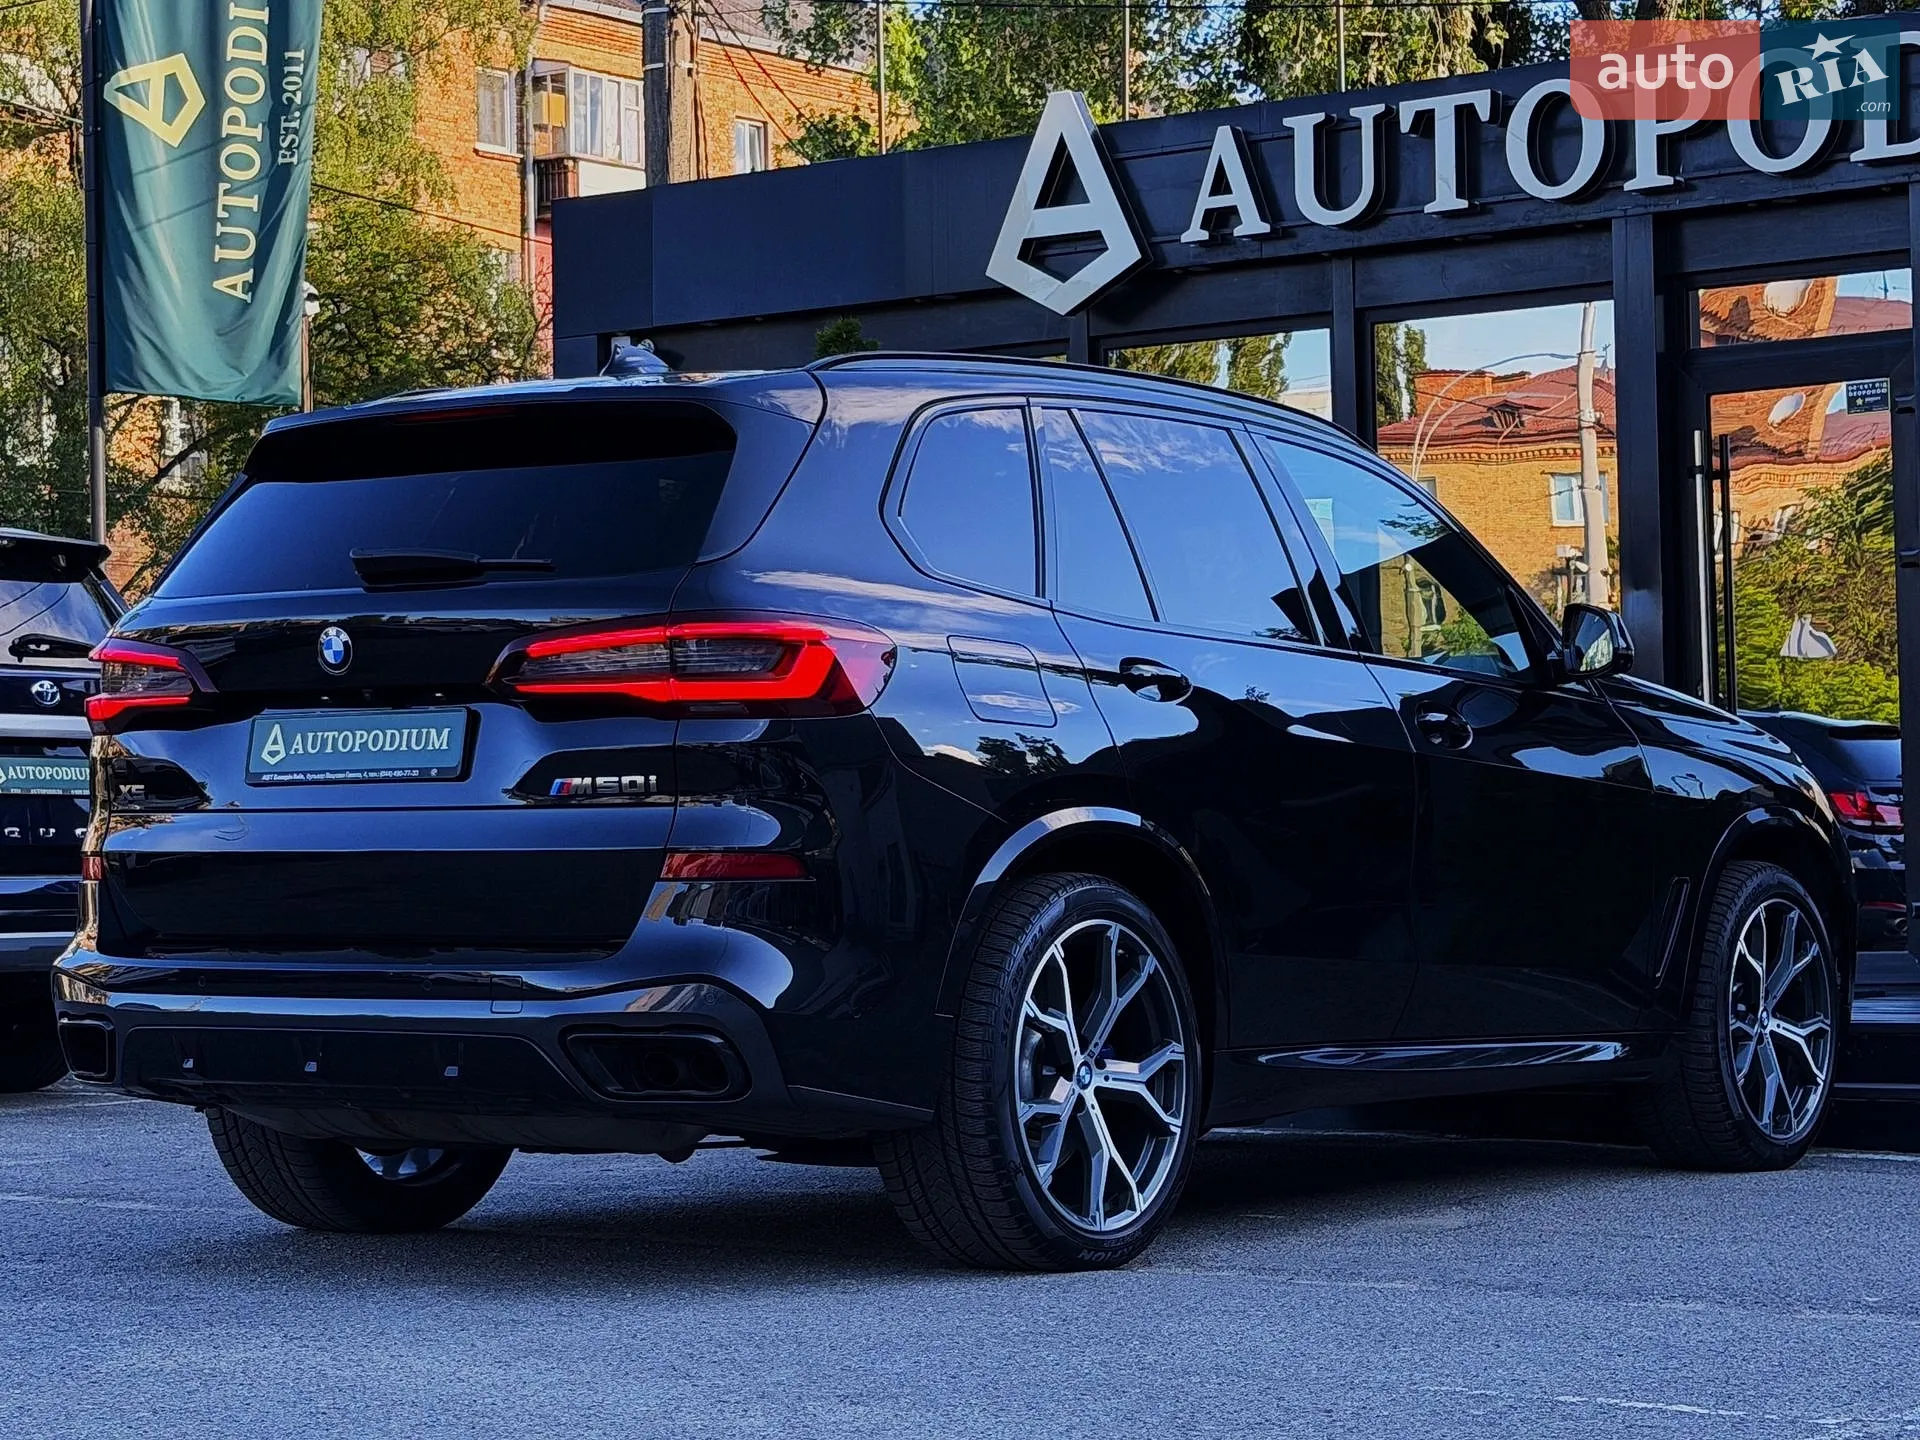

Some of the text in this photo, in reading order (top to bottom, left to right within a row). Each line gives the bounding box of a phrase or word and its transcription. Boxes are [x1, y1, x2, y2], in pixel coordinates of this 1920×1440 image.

[278, 48, 306, 166] EST. 2011
[289, 727, 451, 755] AUTOPODIUM
